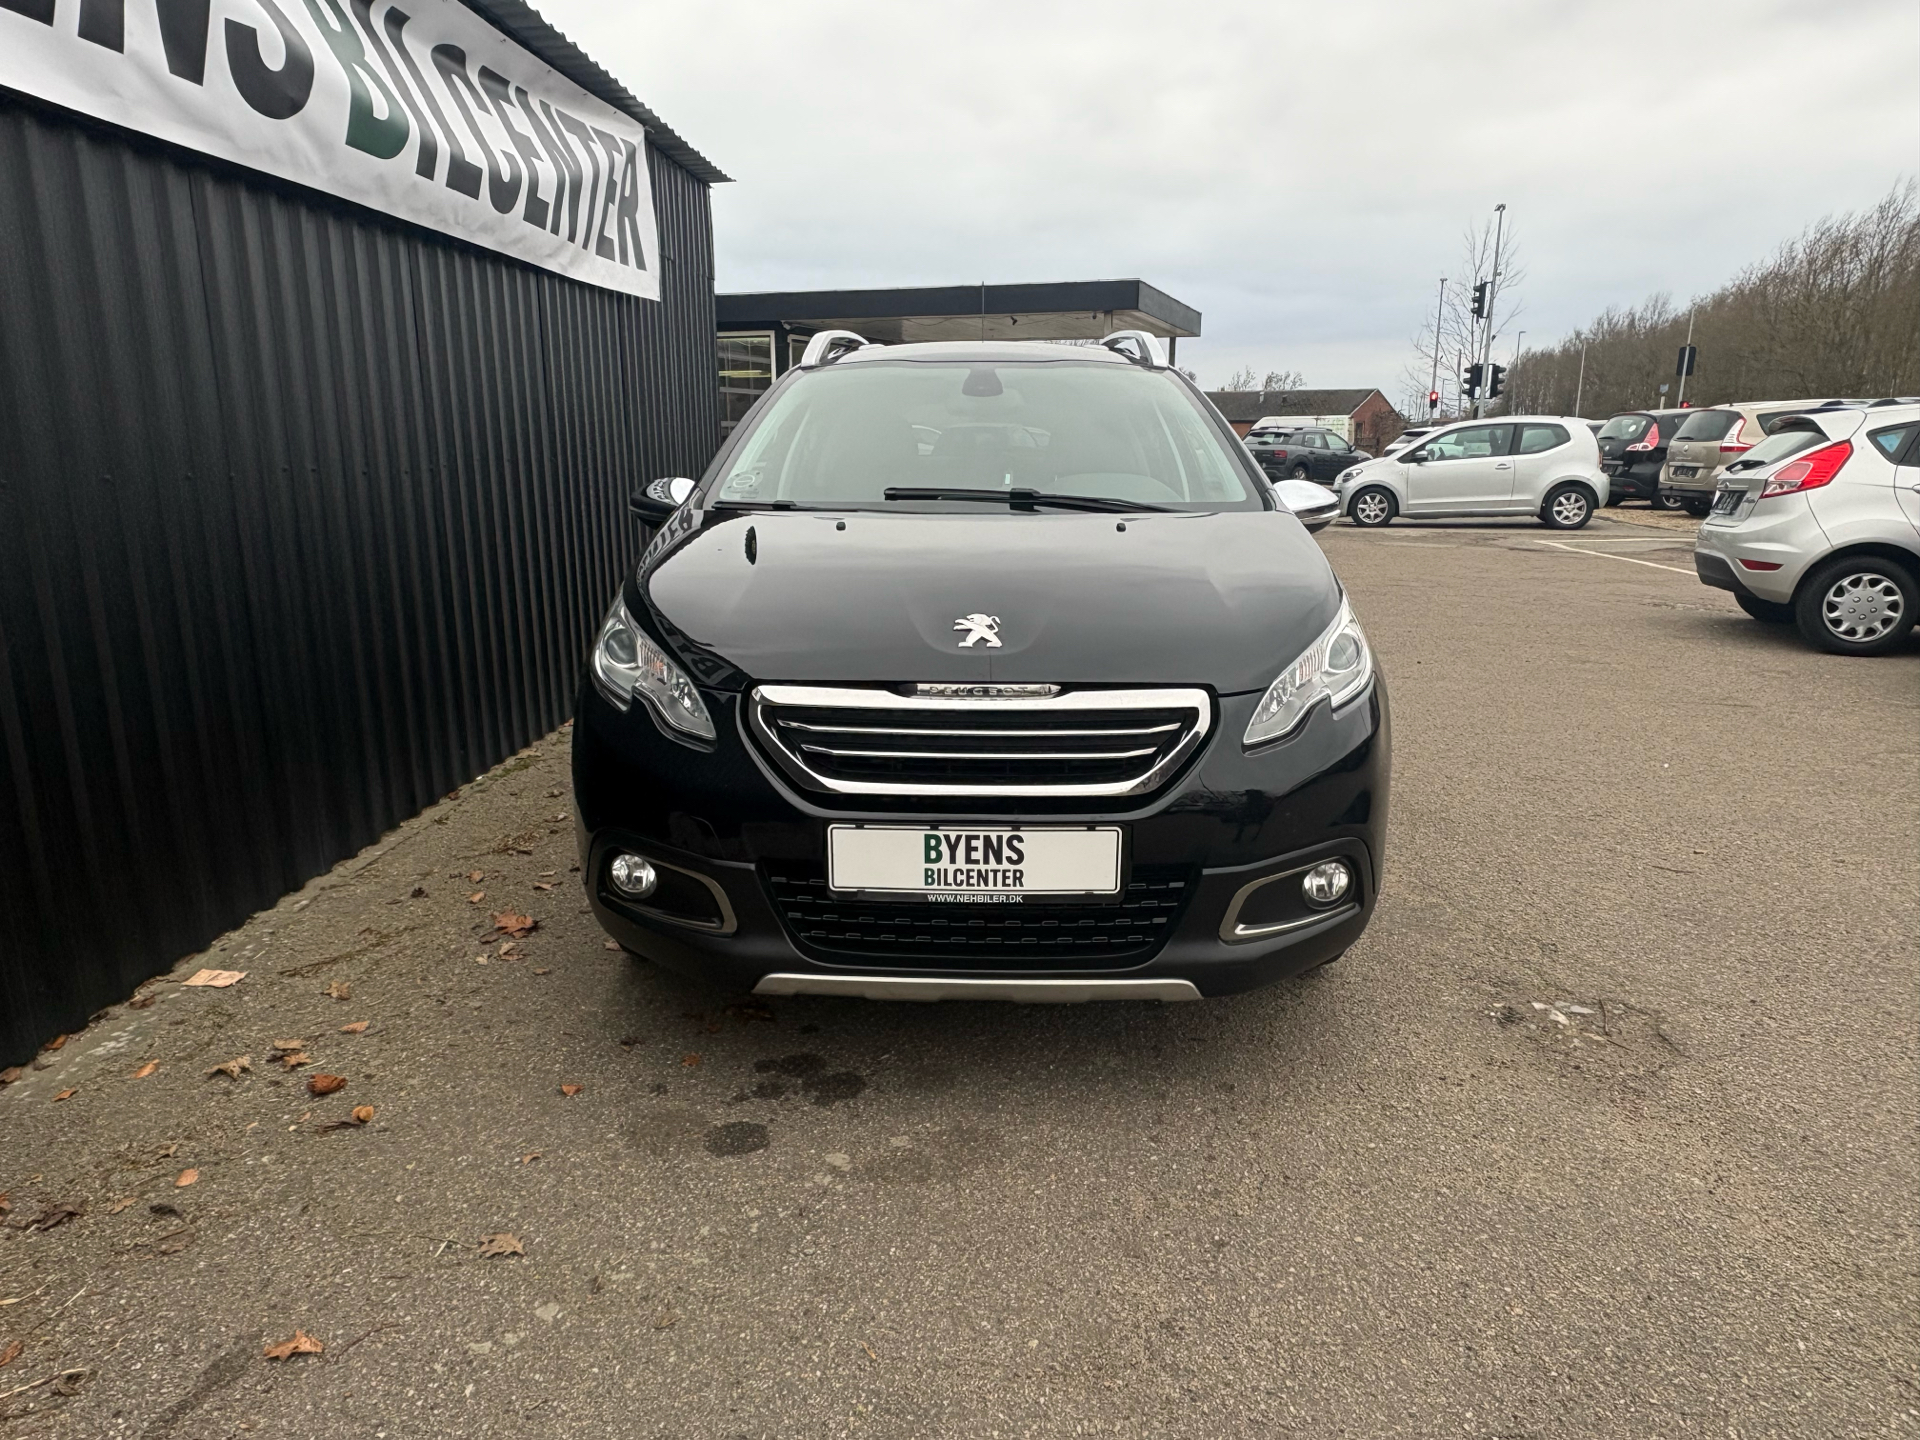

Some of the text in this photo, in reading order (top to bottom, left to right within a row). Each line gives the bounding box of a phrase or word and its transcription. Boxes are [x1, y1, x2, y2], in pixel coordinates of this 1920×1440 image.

[303, 0, 647, 272] BILCENTER
[929, 686, 1029, 696] PEUGEOT
[924, 833, 1025, 866] BYENS
[924, 867, 1025, 888] BILCENTER
[927, 893, 1024, 904] WWW.NEHBILER.DK
